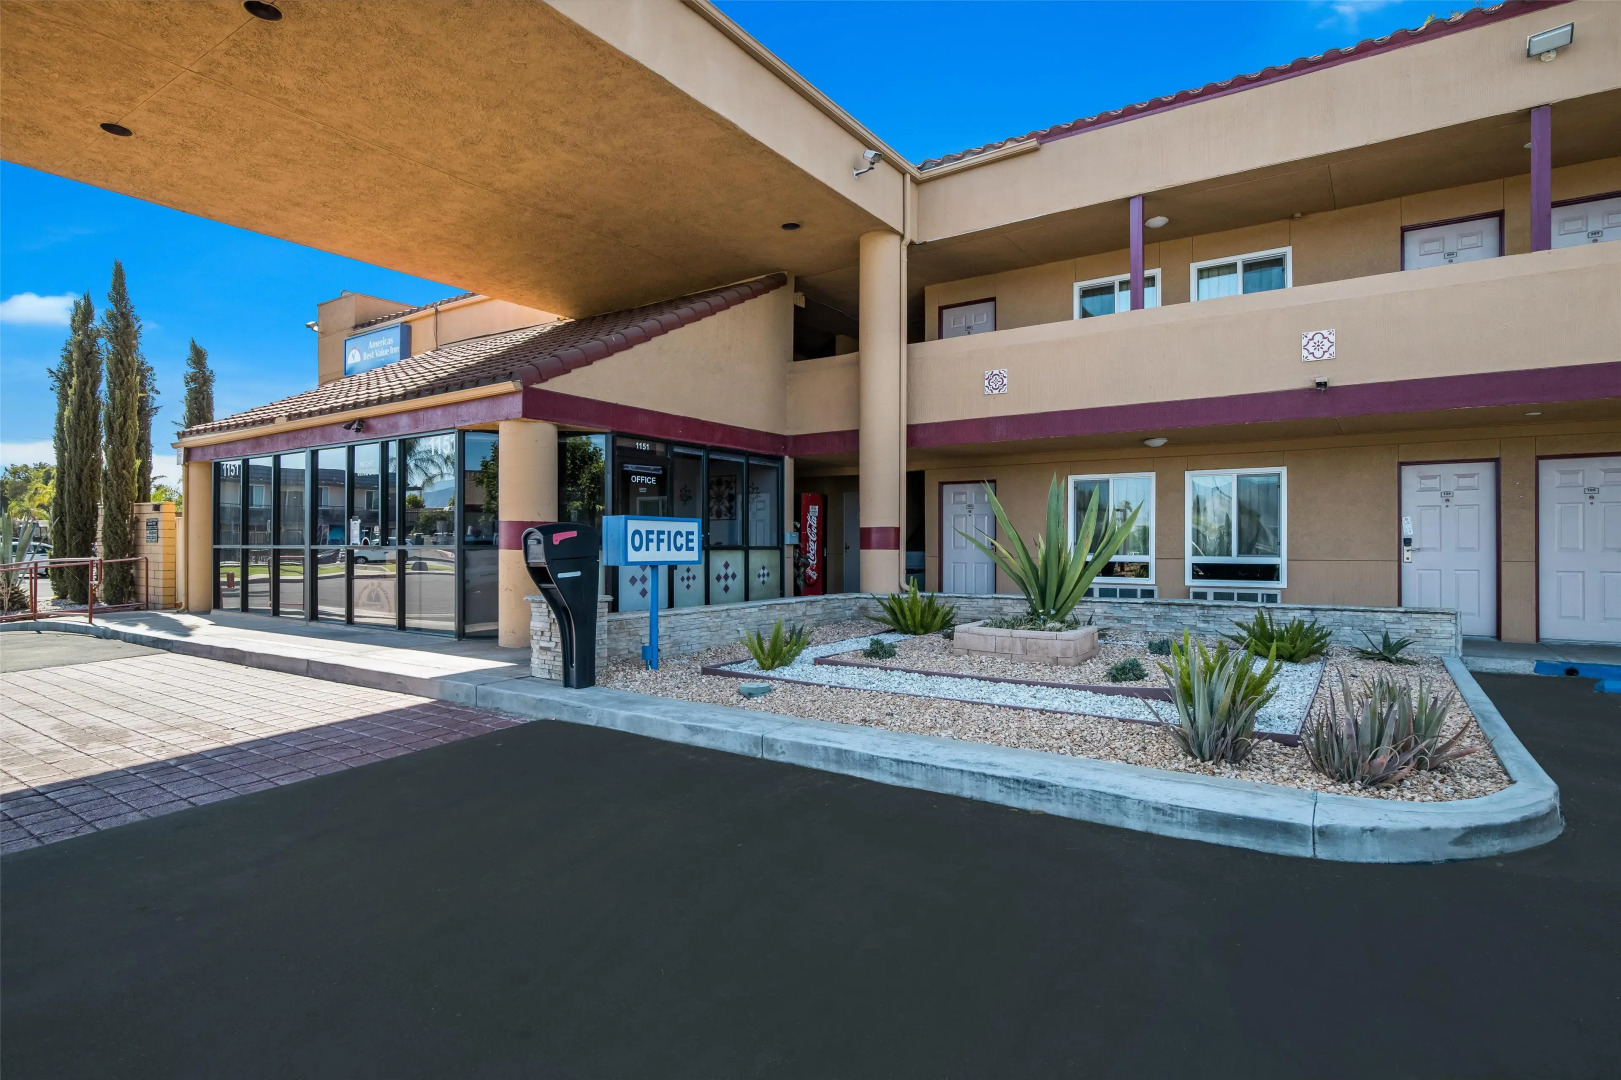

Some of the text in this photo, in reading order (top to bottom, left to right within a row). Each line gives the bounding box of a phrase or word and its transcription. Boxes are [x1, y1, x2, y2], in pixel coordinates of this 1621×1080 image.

[368, 337, 394, 349] Americas
[363, 345, 400, 360] Best Value Inn
[636, 442, 650, 451] 1151
[222, 463, 239, 477] 1151
[630, 475, 657, 485] OFFICE
[630, 529, 695, 552] OFFICE
